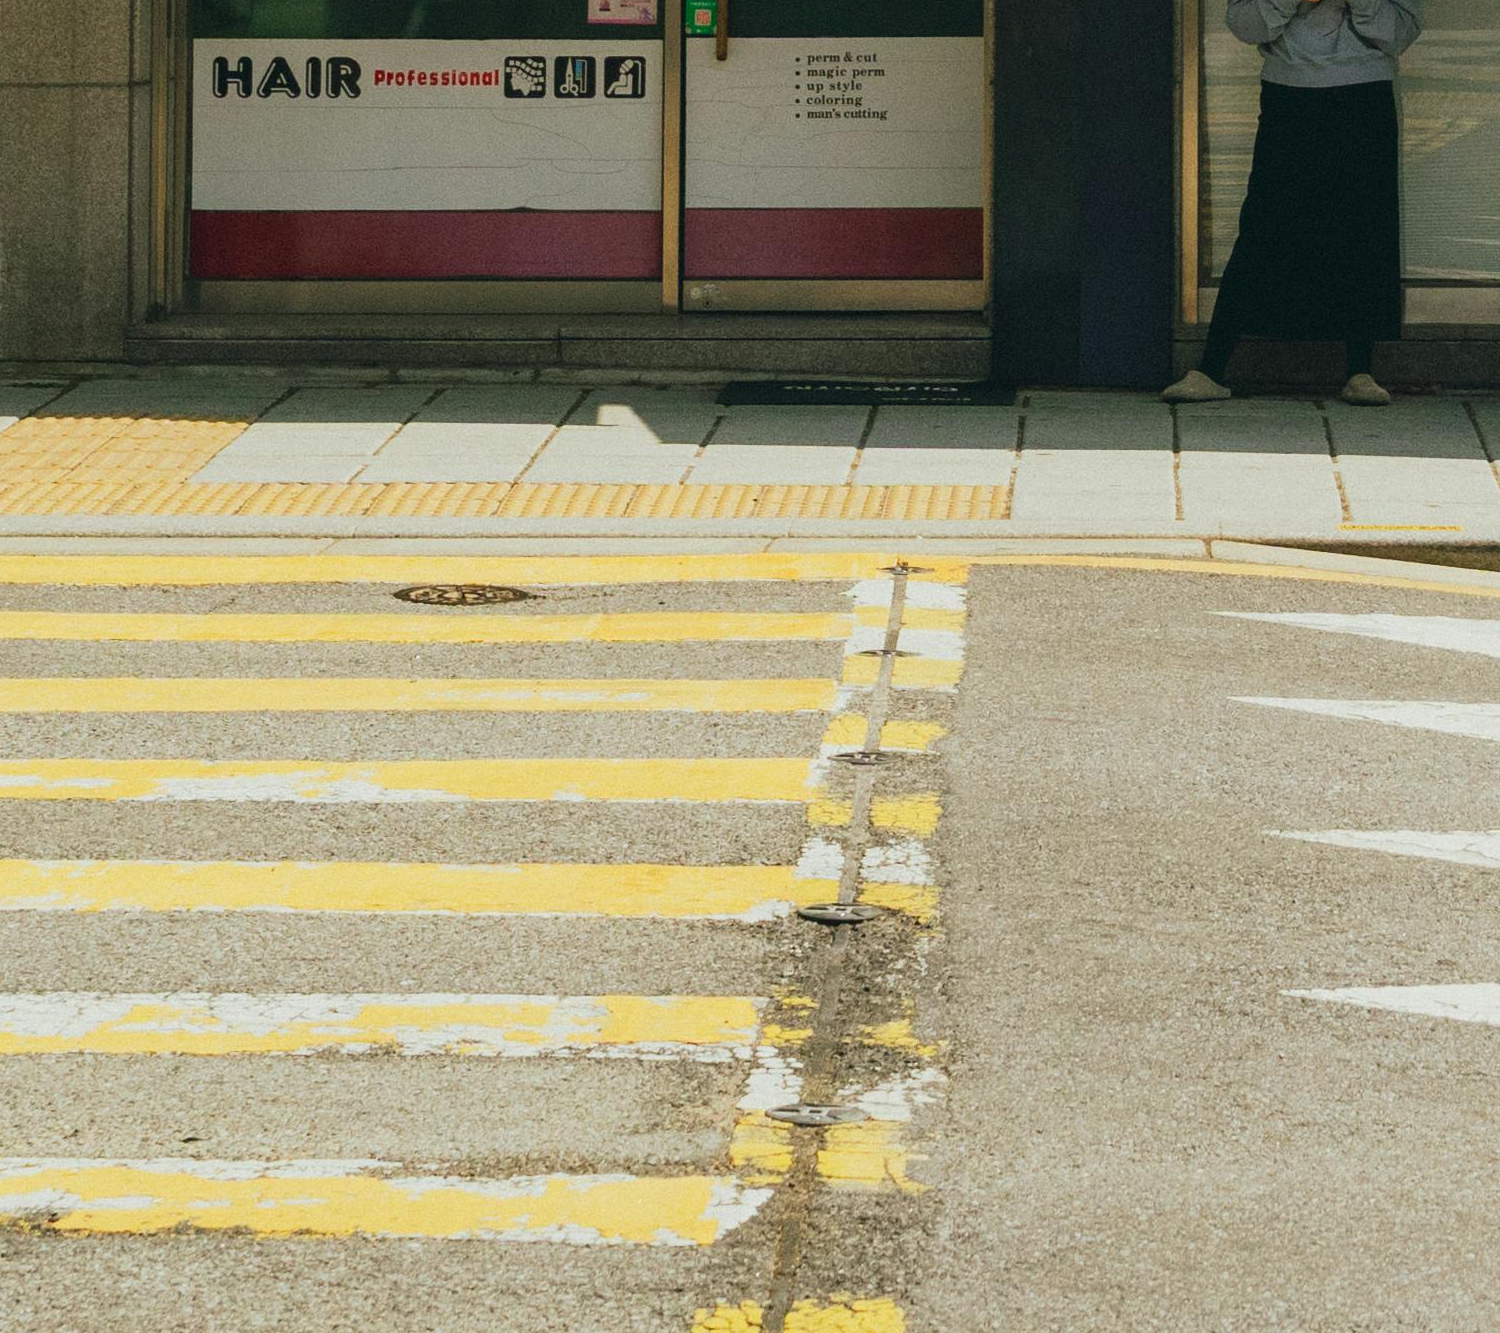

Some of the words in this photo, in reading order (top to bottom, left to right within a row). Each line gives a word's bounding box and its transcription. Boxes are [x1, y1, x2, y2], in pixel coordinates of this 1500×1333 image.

[806, 53, 841, 65] perm
[856, 52, 878, 63] cut
[212, 56, 362, 99] HAIR
[374, 69, 500, 87] Professional
[806, 65, 847, 79] magic
[852, 68, 885, 79] perm
[806, 82, 824, 93] up
[829, 80, 863, 93] style
[806, 94, 863, 107] coloring
[806, 108, 841, 119] man's
[843, 108, 888, 120] cutting
